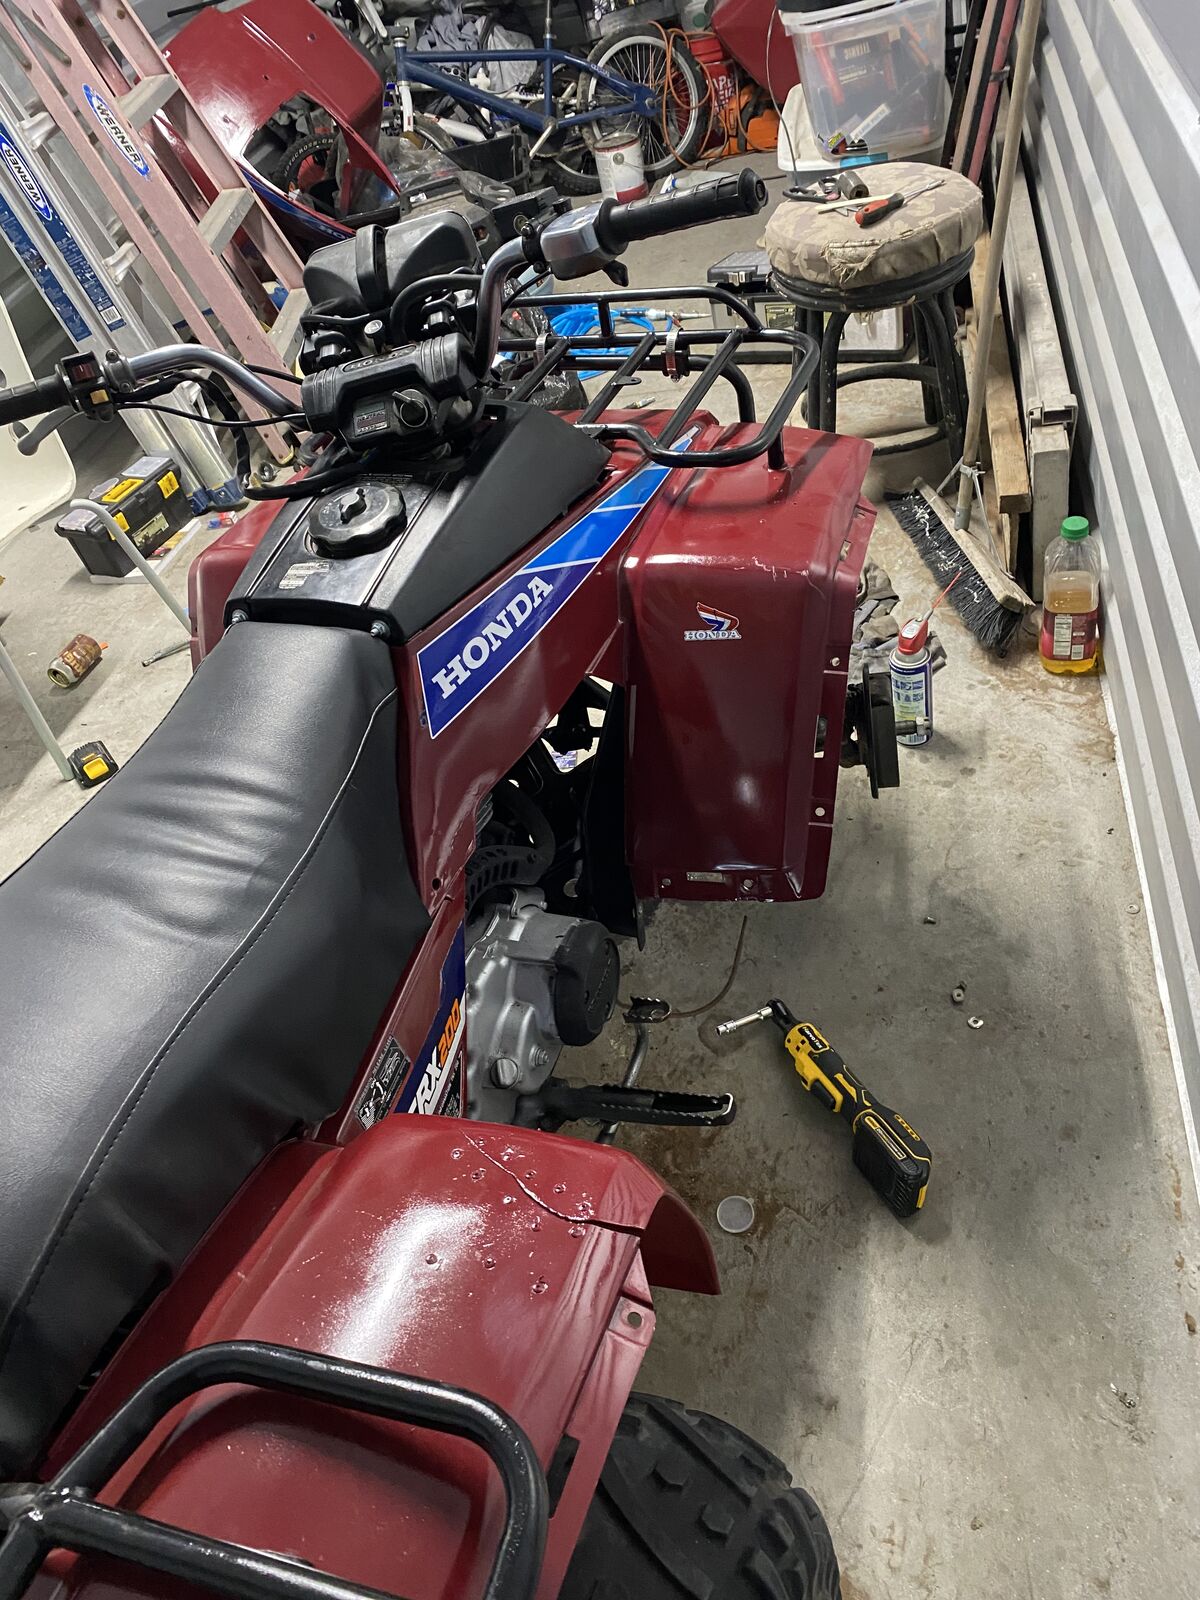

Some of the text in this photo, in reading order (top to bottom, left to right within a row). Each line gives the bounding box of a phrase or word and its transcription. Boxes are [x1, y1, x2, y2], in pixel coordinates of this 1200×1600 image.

[95, 103, 142, 164] WERNER
[5, 148, 41, 202] WERNER
[431, 576, 553, 699] HONDA
[684, 630, 741, 640] HONDA
[438, 998, 460, 1067] 200
